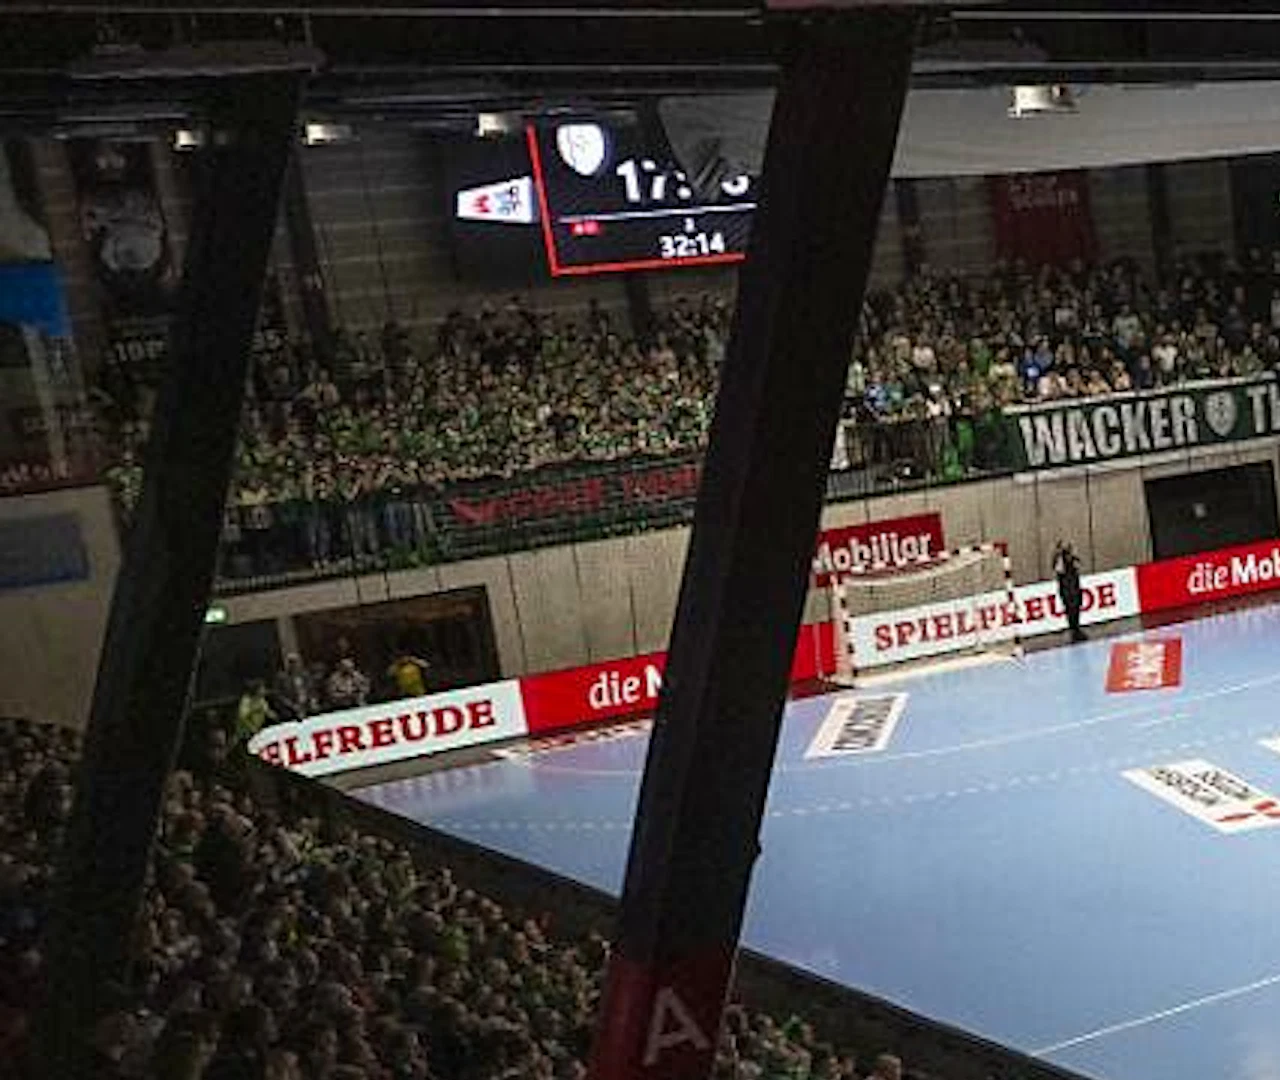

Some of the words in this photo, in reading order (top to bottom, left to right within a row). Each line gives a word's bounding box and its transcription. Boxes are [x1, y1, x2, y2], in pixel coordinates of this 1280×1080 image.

[658, 231, 726, 260] 32:14
[1019, 396, 1199, 466] WACKER
[1187, 561, 1228, 594] die
[588, 671, 640, 710] die
[258, 698, 496, 767] ELFREUDE
[642, 986, 710, 1068] A
